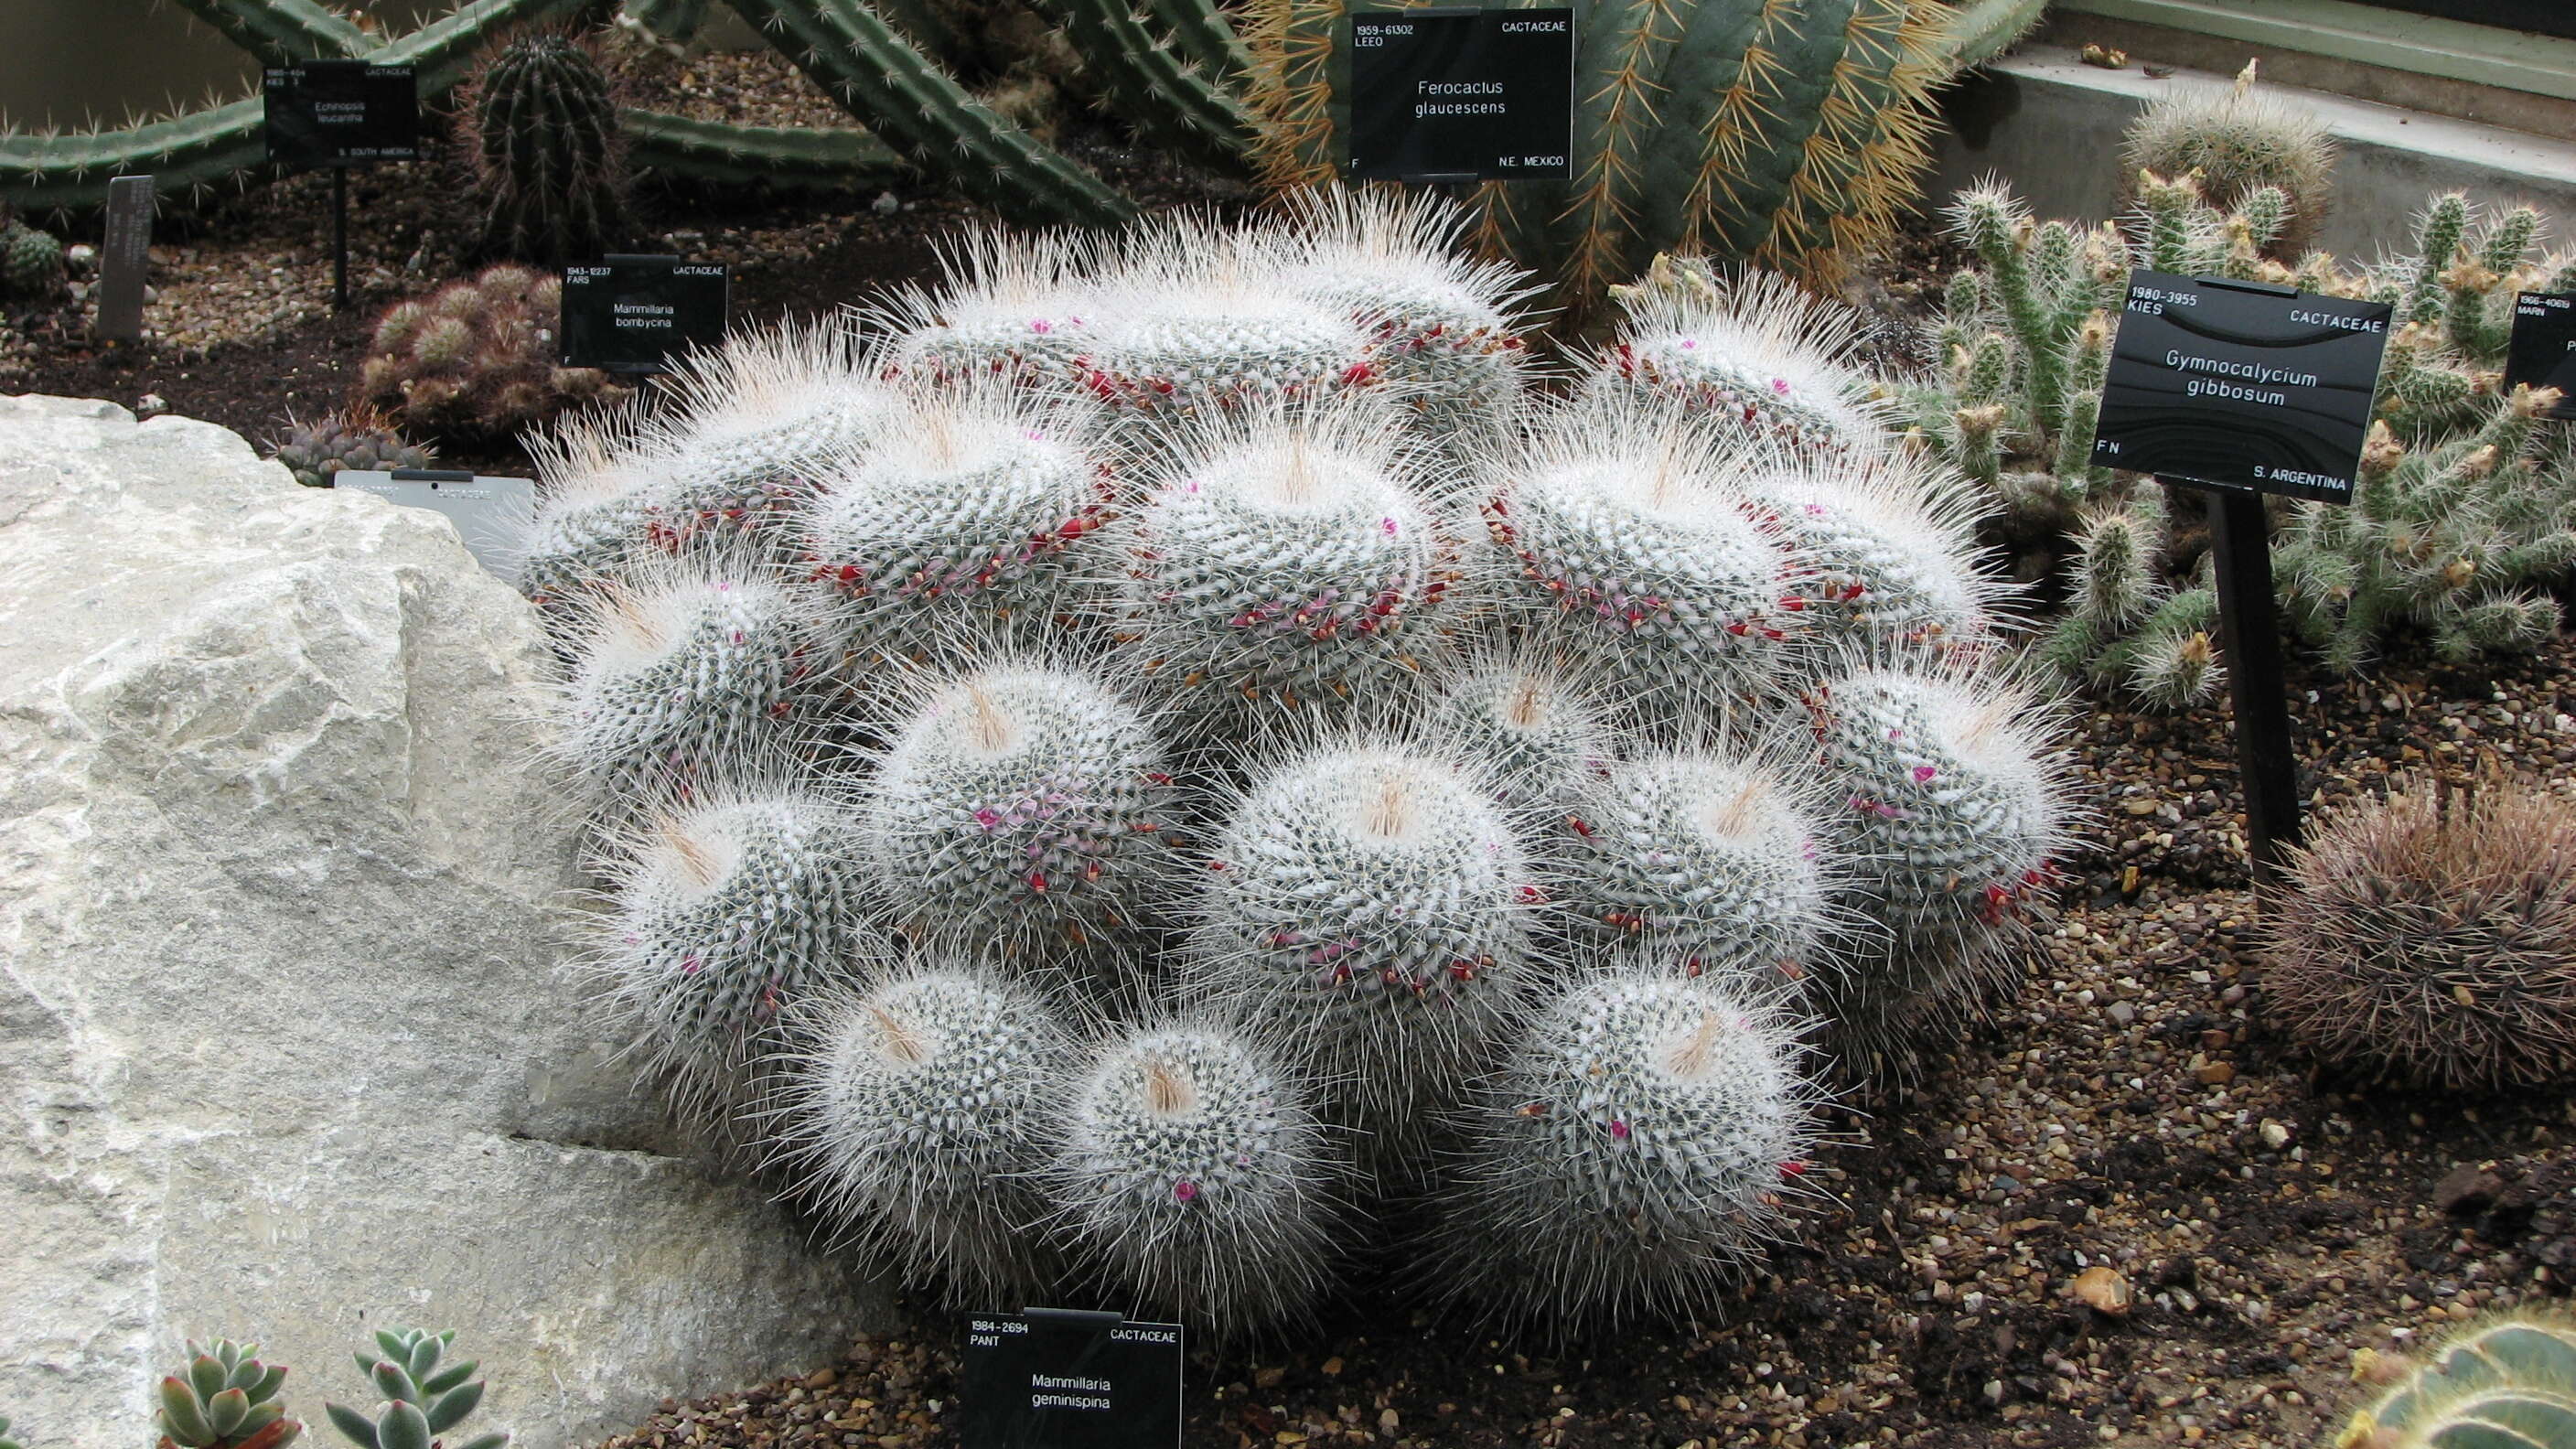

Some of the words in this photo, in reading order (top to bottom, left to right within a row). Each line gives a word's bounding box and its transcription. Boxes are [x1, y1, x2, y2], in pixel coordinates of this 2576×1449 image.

[1356, 25, 1413, 36] 1959-61302
[1501, 21, 1566, 33] CACTACEAE
[366, 68, 411, 76] CACTACEAE
[1418, 80, 1503, 94] Ferocactus
[315, 102, 366, 113] Echinopsis
[1415, 102, 1506, 118] glaucescens
[1351, 158, 1359, 168] F
[1523, 156, 1564, 166] MEXICO
[673, 266, 724, 275] CACTACEAE
[566, 275, 590, 284] FARS
[2131, 285, 2198, 307] 1980-3955
[614, 304, 674, 314] Mammillaria
[2127, 299, 2163, 316] KIES
[2517, 306, 2545, 317] MARN
[616, 317, 672, 329] bombycina
[2290, 309, 2383, 334] CACTACEAE
[2165, 349, 2318, 388] Gymnocalycium
[2187, 379, 2285, 406] gibbosum
[2253, 466, 2266, 478] S.
[2270, 467, 2346, 491] ARGENTINA
[971, 1321, 1029, 1333] 1984-2694
[970, 1335, 1000, 1347] PANT
[1110, 1329, 1176, 1343] CACTACEAE
[1032, 1374, 1111, 1390] Mammillaria
[1032, 1393, 1111, 1410] geminispina
